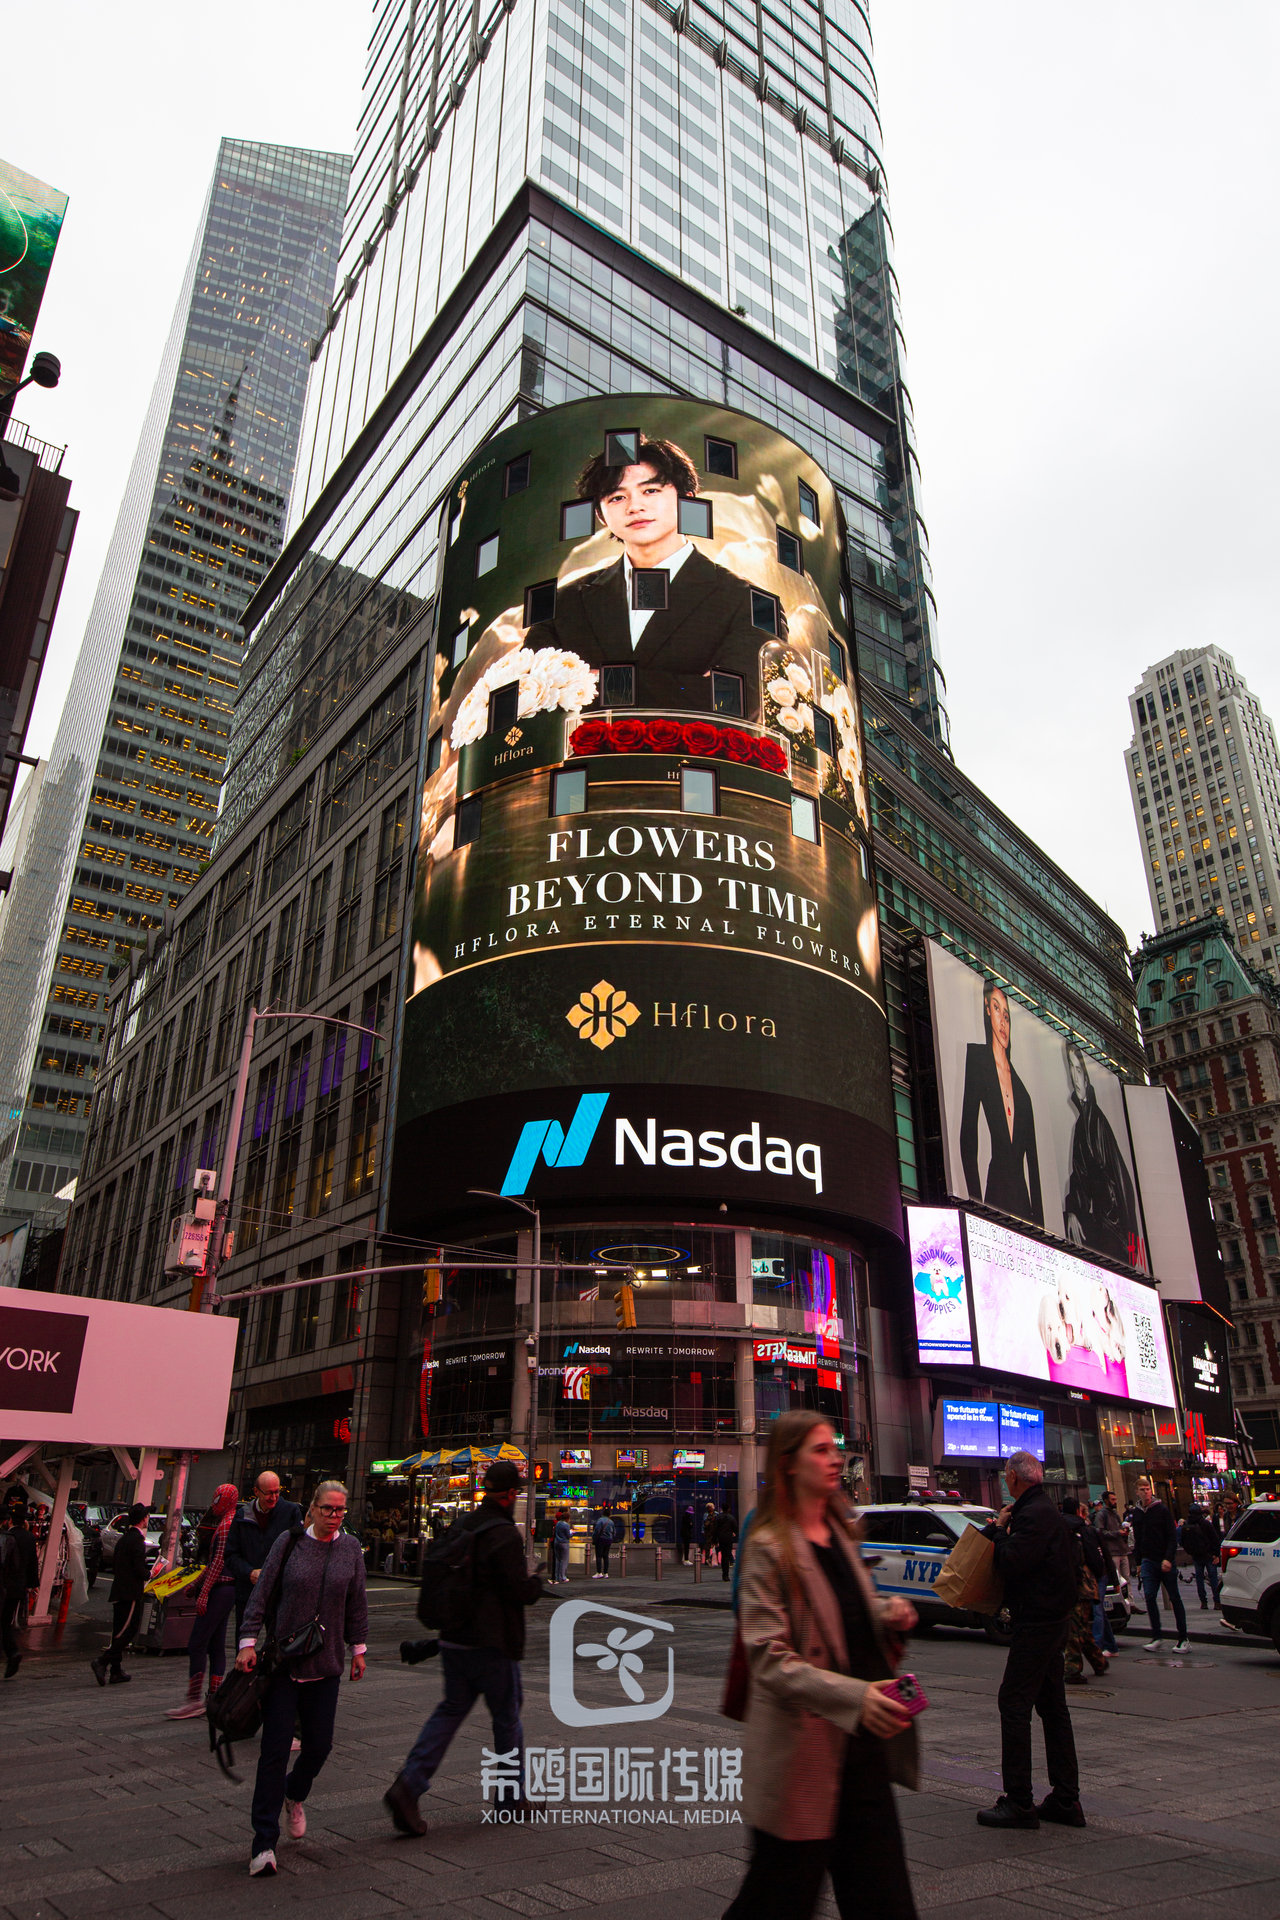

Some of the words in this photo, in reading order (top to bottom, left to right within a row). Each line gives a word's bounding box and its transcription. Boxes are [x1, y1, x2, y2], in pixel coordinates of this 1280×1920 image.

[494, 745, 534, 766] Hflora
[546, 826, 776, 871] FLOWERS
[506, 872, 703, 917] BEYOND
[718, 878, 821, 932] TIME
[454, 920, 560, 959] HFLORA
[584, 914, 735, 935] ETERNAL
[757, 926, 860, 976] FLOWERS
[654, 1002, 777, 1038] Hflora
[615, 1118, 823, 1194] Nasdaq
[967, 1215, 1013, 1248] BRINGING
[916, 1248, 958, 1268] NATIONWIDE
[969, 1239, 991, 1263] ONE
[992, 1247, 1015, 1271] WAG
[1127, 1231, 1147, 1273] H&M
[923, 1299, 957, 1315] PUPPIES
[445, 1355, 467, 1366] REWRITE
[469, 1351, 506, 1362] TOMORROW
[579, 1345, 611, 1356] Nasdaq
[626, 1346, 664, 1355] REWRITE
[668, 1347, 716, 1356] TOMORROW
[623, 1406, 668, 1420] Nasdaq
[946, 1405, 959, 1413] The
[959, 1406, 979, 1414] future
[946, 1414, 966, 1422] spend
[903, 1559, 942, 1584] NYP
